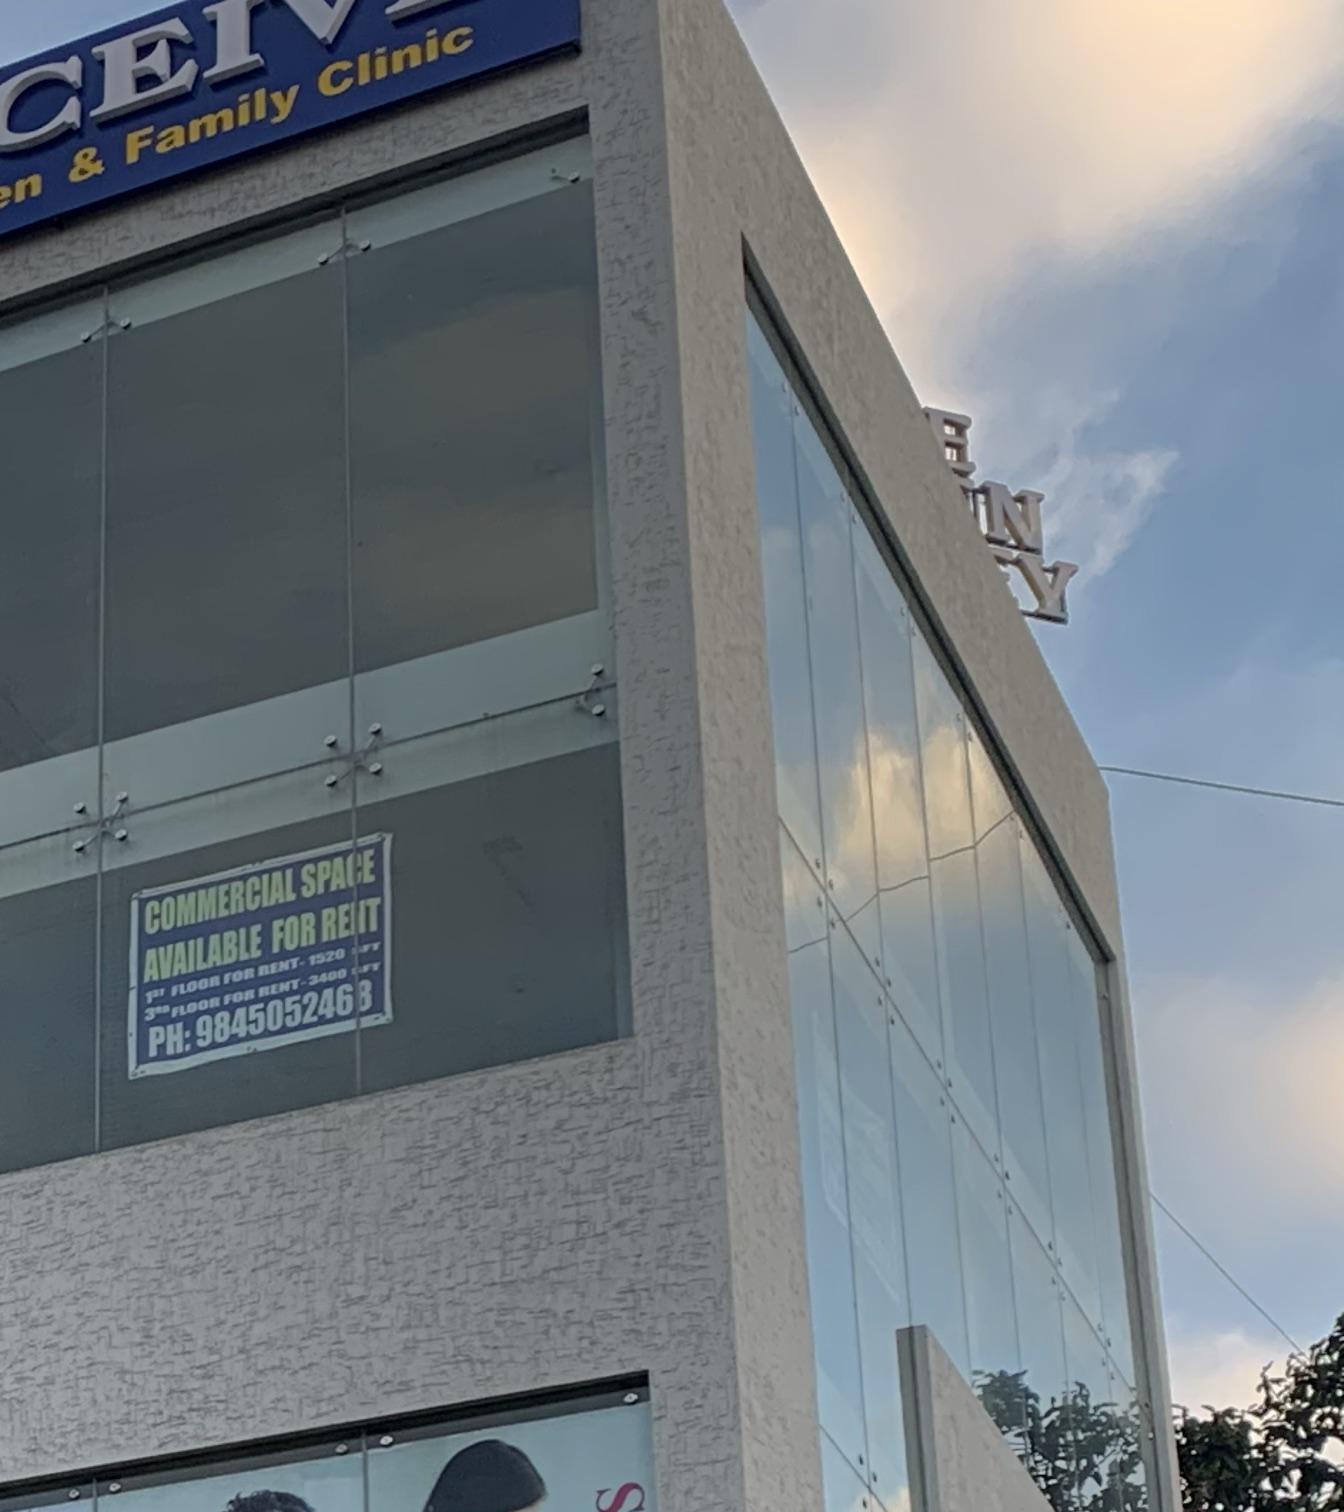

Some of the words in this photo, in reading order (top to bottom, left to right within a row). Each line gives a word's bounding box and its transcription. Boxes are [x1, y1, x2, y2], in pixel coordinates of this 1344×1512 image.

[68, 145, 106, 184] &
[124, 82, 301, 166] Family
[317, 24, 475, 97] Clinic
[144, 867, 297, 935] COMMERCIAL
[300, 848, 376, 899] SPACE
[143, 923, 262, 984] AVAILABLE
[271, 912, 316, 954] FOR
[321, 897, 382, 943] RENT
[171, 975, 221, 997] FLOOR
[223, 967, 255, 985] FOR
[171, 996, 221, 1018] FLOOR
[223, 988, 255, 1006] FOR
[148, 1021, 191, 1058] PH:
